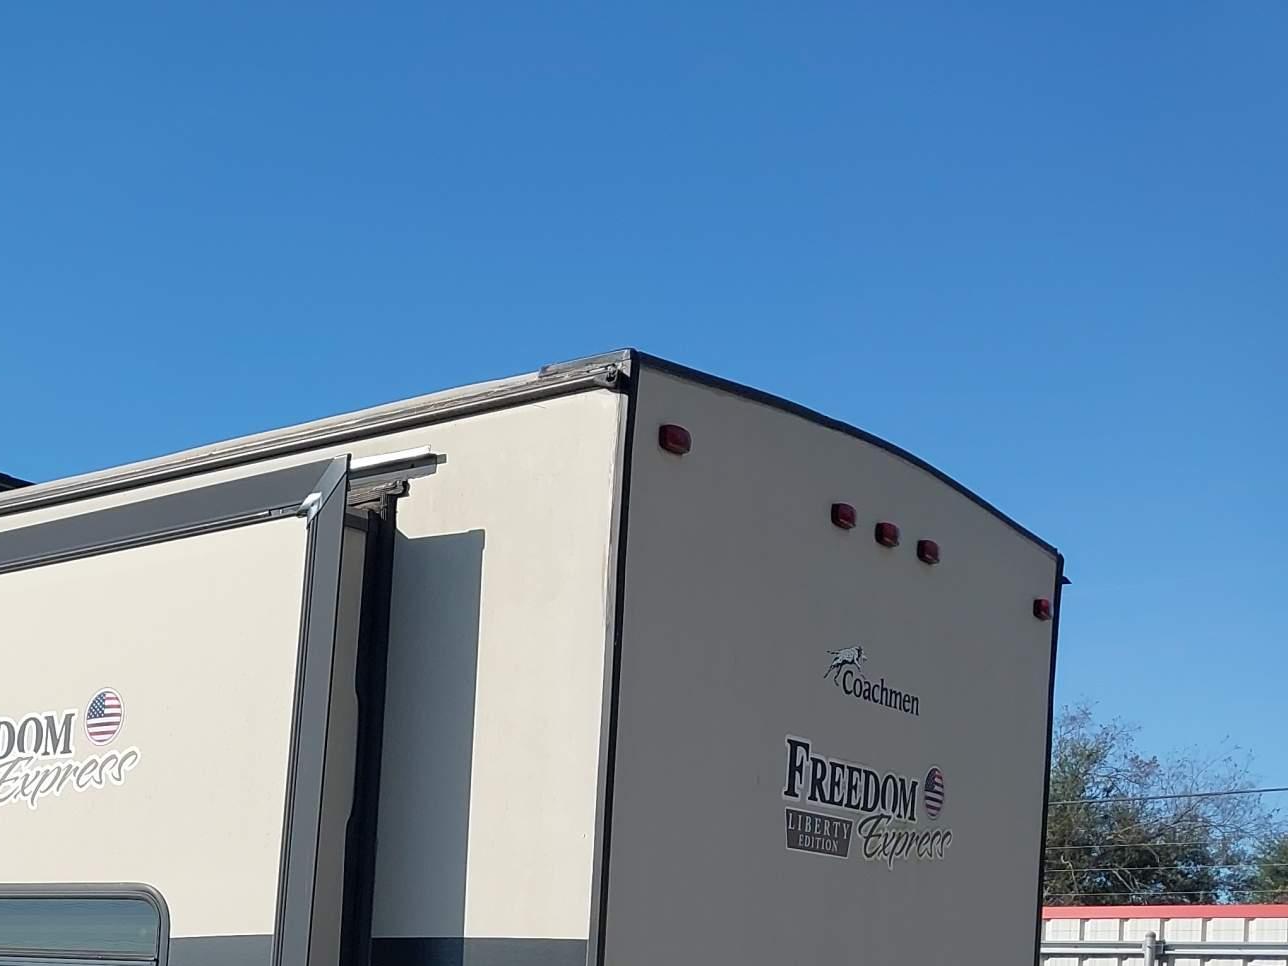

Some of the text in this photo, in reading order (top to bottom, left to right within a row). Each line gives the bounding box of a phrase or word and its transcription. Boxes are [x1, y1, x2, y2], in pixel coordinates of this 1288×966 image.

[842, 669, 920, 716] Coachmen
[784, 737, 919, 822] FREEDOM
[787, 812, 851, 840] LIBERTY
[798, 835, 839, 852] EDITION
[858, 814, 952, 867] Express
